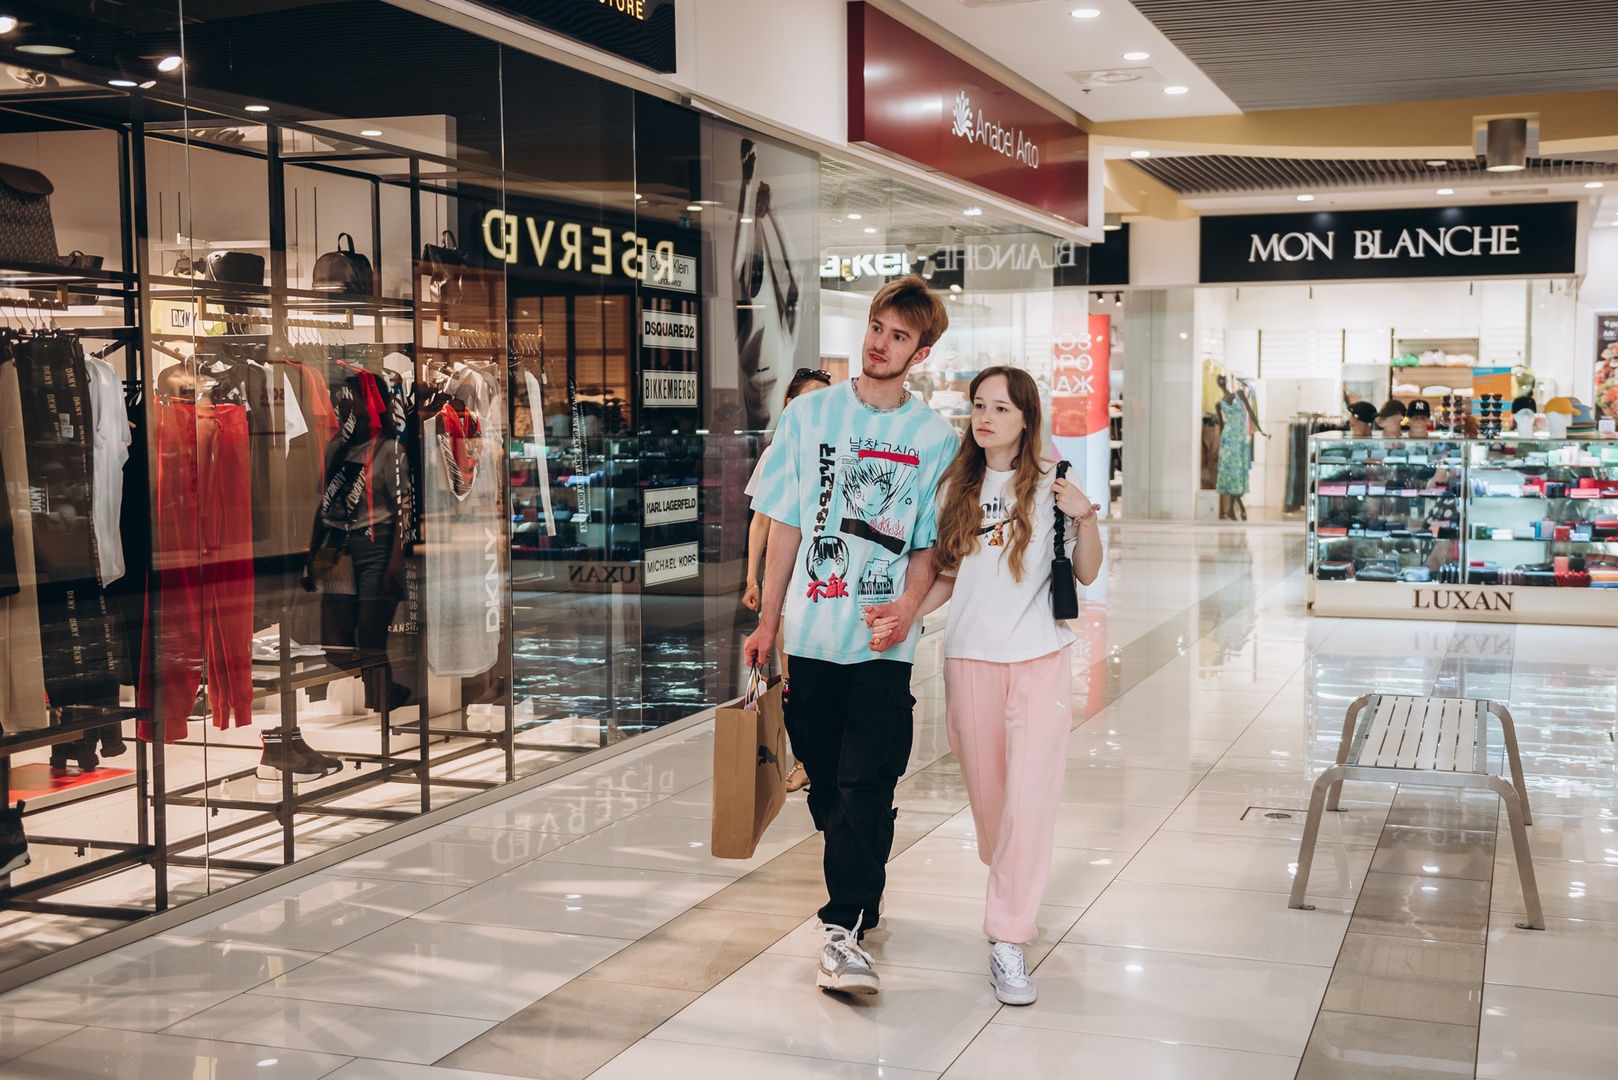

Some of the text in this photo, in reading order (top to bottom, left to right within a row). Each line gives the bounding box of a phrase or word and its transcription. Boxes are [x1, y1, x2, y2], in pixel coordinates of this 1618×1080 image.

[599, 0, 644, 20] ORE
[975, 109, 1014, 158] Anabel
[1248, 224, 1520, 262] MON BLANCHE
[644, 320, 695, 339] DSQUARED2
[1051, 332, 1092, 351] ОЗ
[66, 367, 77, 388] DKNY
[1052, 374, 1095, 394] АЖ
[645, 378, 696, 400] BIKKEMBERGS
[47, 394, 57, 414] DKNY
[30, 485, 42, 513] DKNY
[646, 498, 696, 514] KARL LAGERFELD
[980, 496, 1013, 519] nik
[647, 554, 697, 573] MICHAEL KORS
[484, 526, 500, 632] DKNY
[67, 590, 76, 610] DKNY
[1412, 589, 1514, 612] LUXAN
[69, 618, 80, 637] DKNY
[73, 645, 83, 664] DKNY
